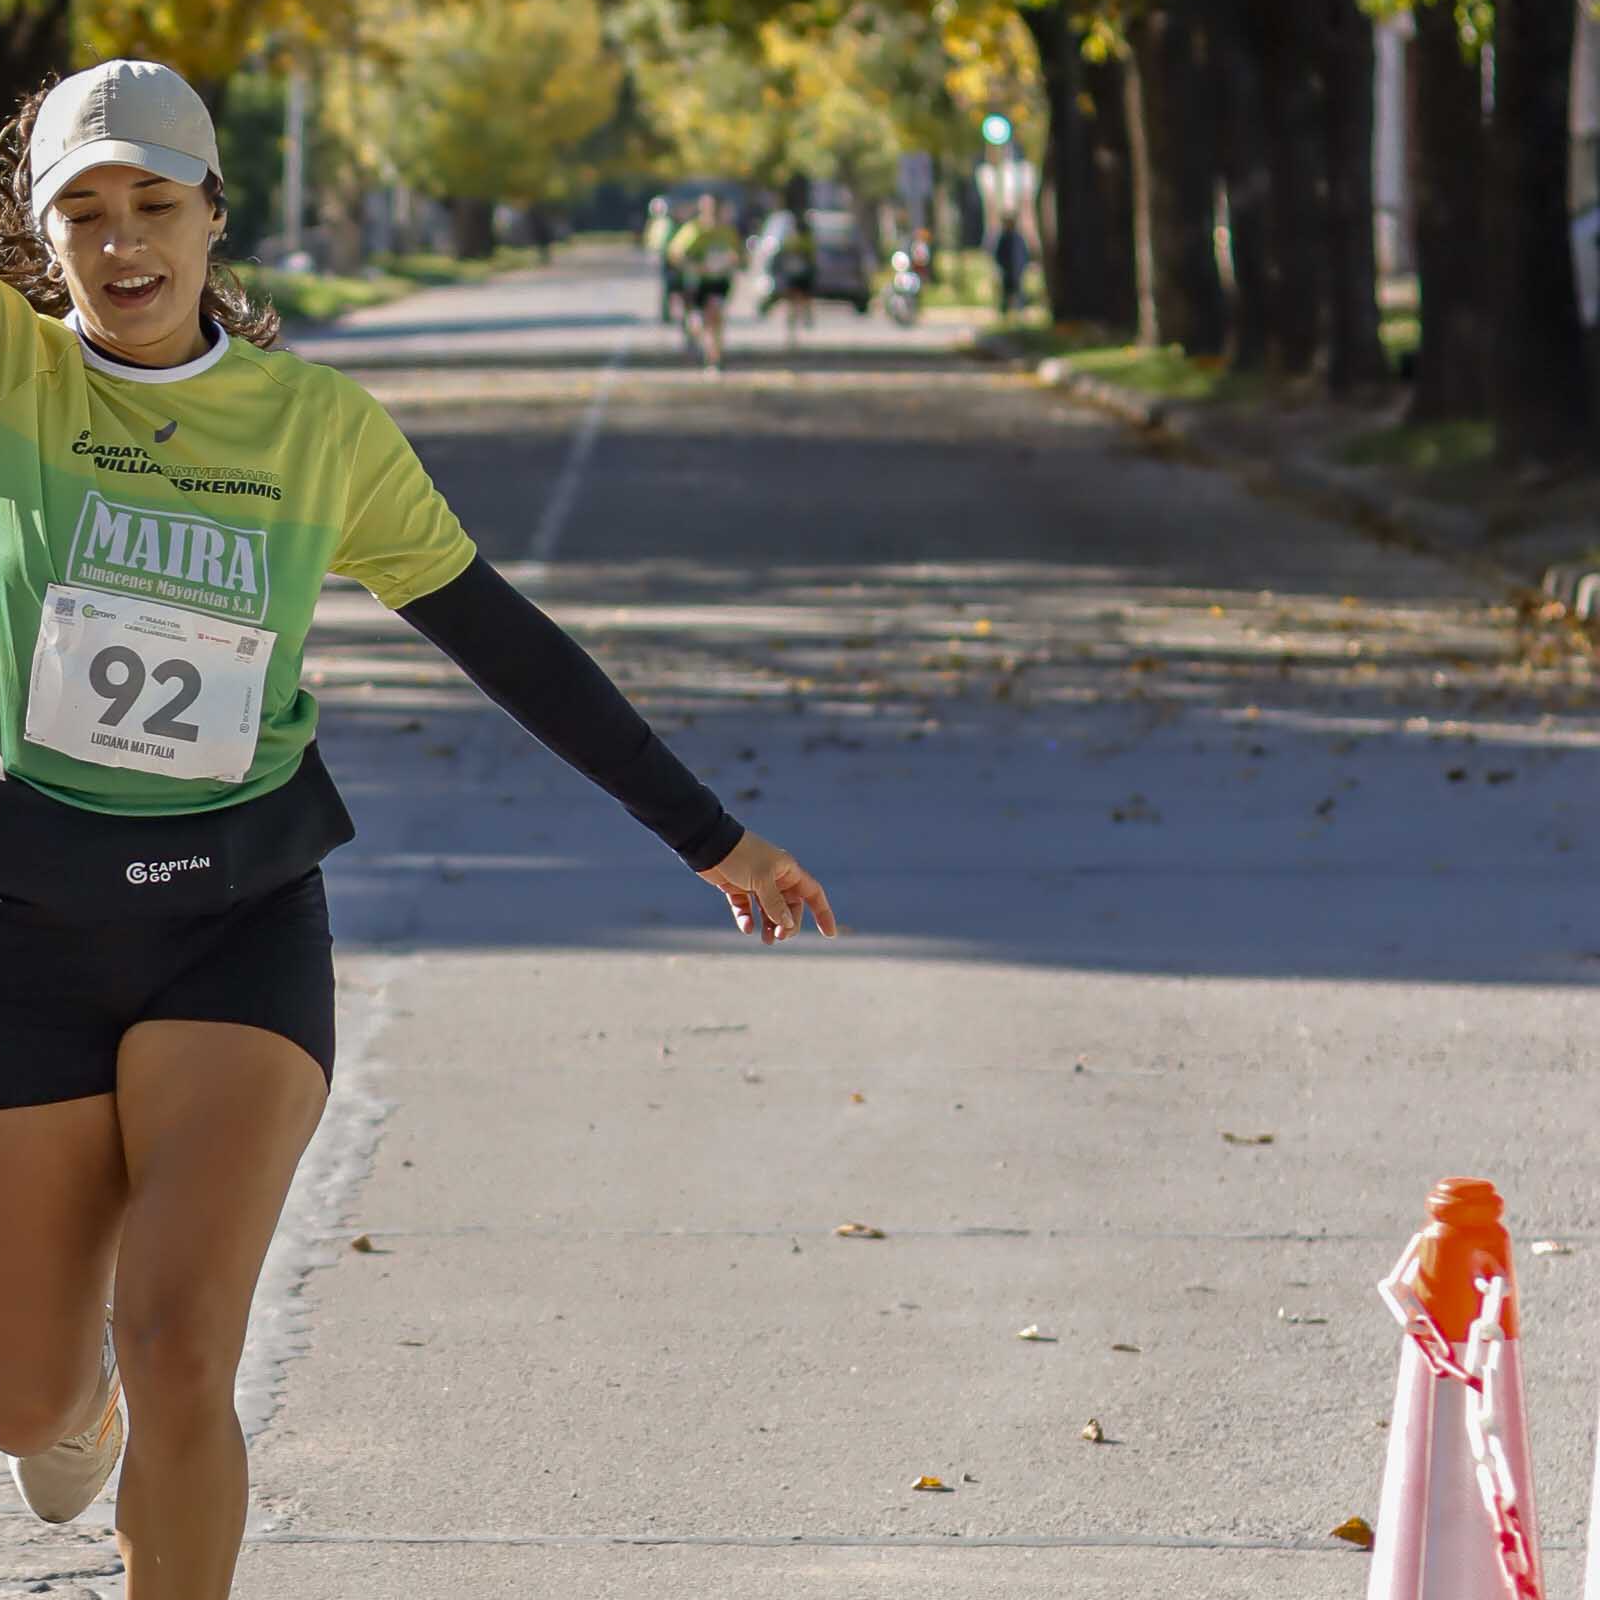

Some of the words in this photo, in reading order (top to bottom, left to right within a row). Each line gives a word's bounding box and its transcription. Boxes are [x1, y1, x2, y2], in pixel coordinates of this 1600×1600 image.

[83, 501, 257, 594] MAIRA
[79, 562, 153, 592] Almacenes
[156, 579, 229, 610] Mayoristas
[231, 594, 256, 615] S.A.
[89, 645, 202, 742] 92
[90, 731, 129, 751] LUCIANA
[130, 741, 175, 760] MATTALIA
[148, 855, 210, 872] CAPITÁN
[149, 872, 171, 882] GO
